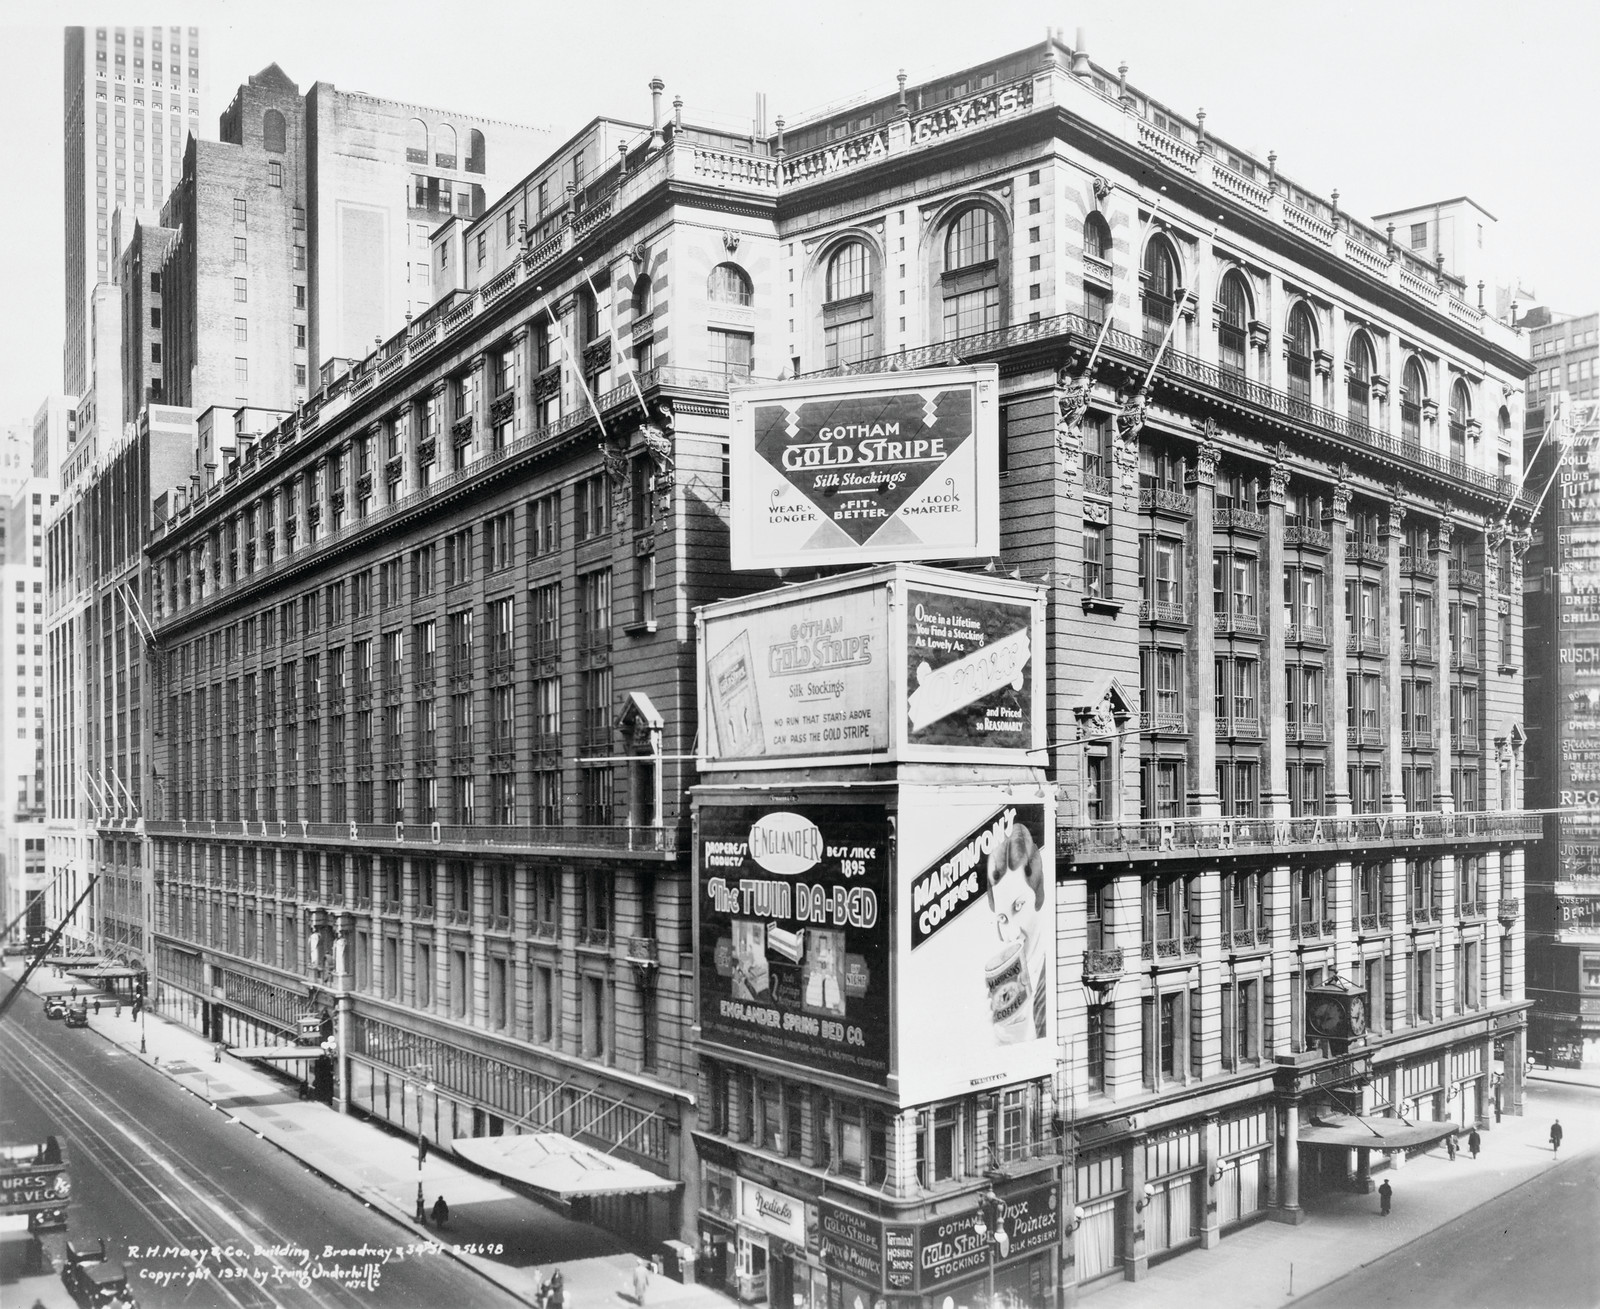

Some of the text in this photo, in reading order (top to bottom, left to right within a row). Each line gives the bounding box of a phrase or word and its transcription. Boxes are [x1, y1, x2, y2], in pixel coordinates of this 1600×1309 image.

[819, 422, 900, 441] GOTHAM
[781, 438, 948, 471] GOLD STRIPE
[813, 471, 907, 490] Silk Stockings
[769, 504, 806, 513] WEAR
[847, 500, 870, 508] FIT
[927, 494, 960, 504] LOOK
[769, 514, 818, 523] LONGER
[834, 509, 889, 520] BETTER
[902, 505, 962, 515] SMARTER
[915, 603, 981, 629] Once in a Lifetime
[790, 616, 843, 640] GOTHAM
[916, 623, 985, 647] You Find a Stocking
[915, 636, 964, 653] As Lovely As
[768, 635, 872, 675] GOLD STRIPE
[789, 680, 844, 698] Silk Stockings
[774, 709, 871, 727] NO RUN THAT STARTS ABOVE
[986, 707, 1022, 718] and Priced
[976, 717, 1023, 732] so REASONABLY
[773, 725, 869, 745] CAN PASS THE GOLD STRIPE
[752, 825, 822, 863] ENGLANDER
[827, 846, 876, 859] BEST SINCE
[841, 860, 865, 878] 1895
[708, 877, 877, 928] The TWIN DA-BED
[919, 871, 979, 934] COFFEE
[720, 1001, 781, 1029] ENGLANDER
[783, 1013, 819, 1036] SPRING
[821, 1020, 845, 1042] BED
[846, 1026, 866, 1047] CO.
[834, 1210, 866, 1229] GOTHAM
[938, 1217, 979, 1238] GOTHAM
[1013, 1212, 1057, 1237] Pointex
[824, 1215, 846, 1234] GOLD
[846, 1225, 878, 1249] STRIPE
[1010, 1229, 1057, 1253] SILK HOSIERY
[887, 1248, 913, 1261] HOSIERY
[921, 1242, 952, 1269] GOLD
[892, 1260, 914, 1271] SHOPS
[934, 1252, 986, 1278] STOCKINGS
